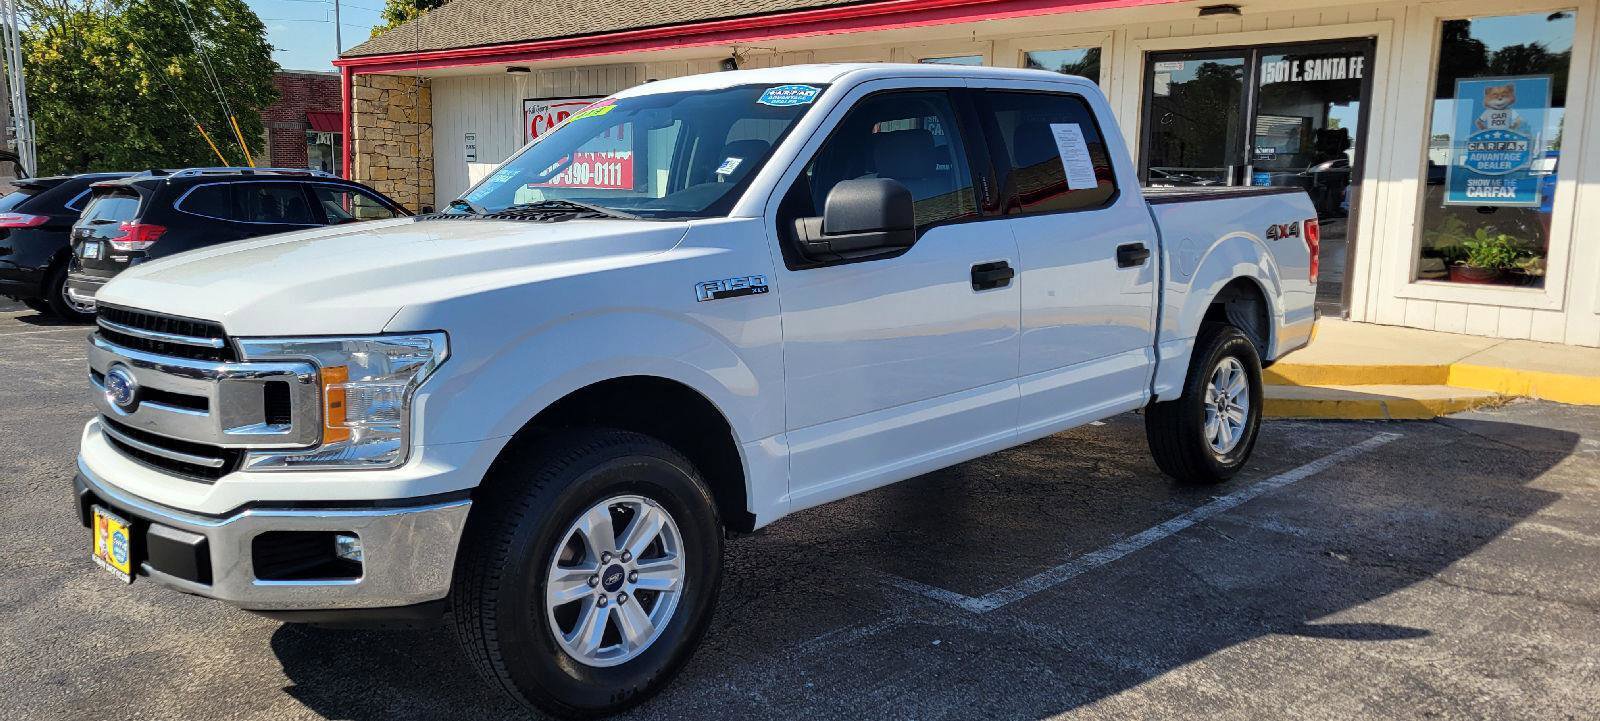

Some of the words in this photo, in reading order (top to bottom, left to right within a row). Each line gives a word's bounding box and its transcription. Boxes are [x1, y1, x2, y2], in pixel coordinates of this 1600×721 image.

[1261, 60, 1290, 83] 1501
[1291, 60, 1302, 82] E.
[1304, 57, 1347, 81] SANTA
[1348, 56, 1364, 79] FE
[1468, 141, 1527, 151] CARFAX
[1471, 152, 1521, 161] ADVANTAGE
[1478, 161, 1512, 169] DEALER
[1466, 186, 1517, 197] CARFAX
